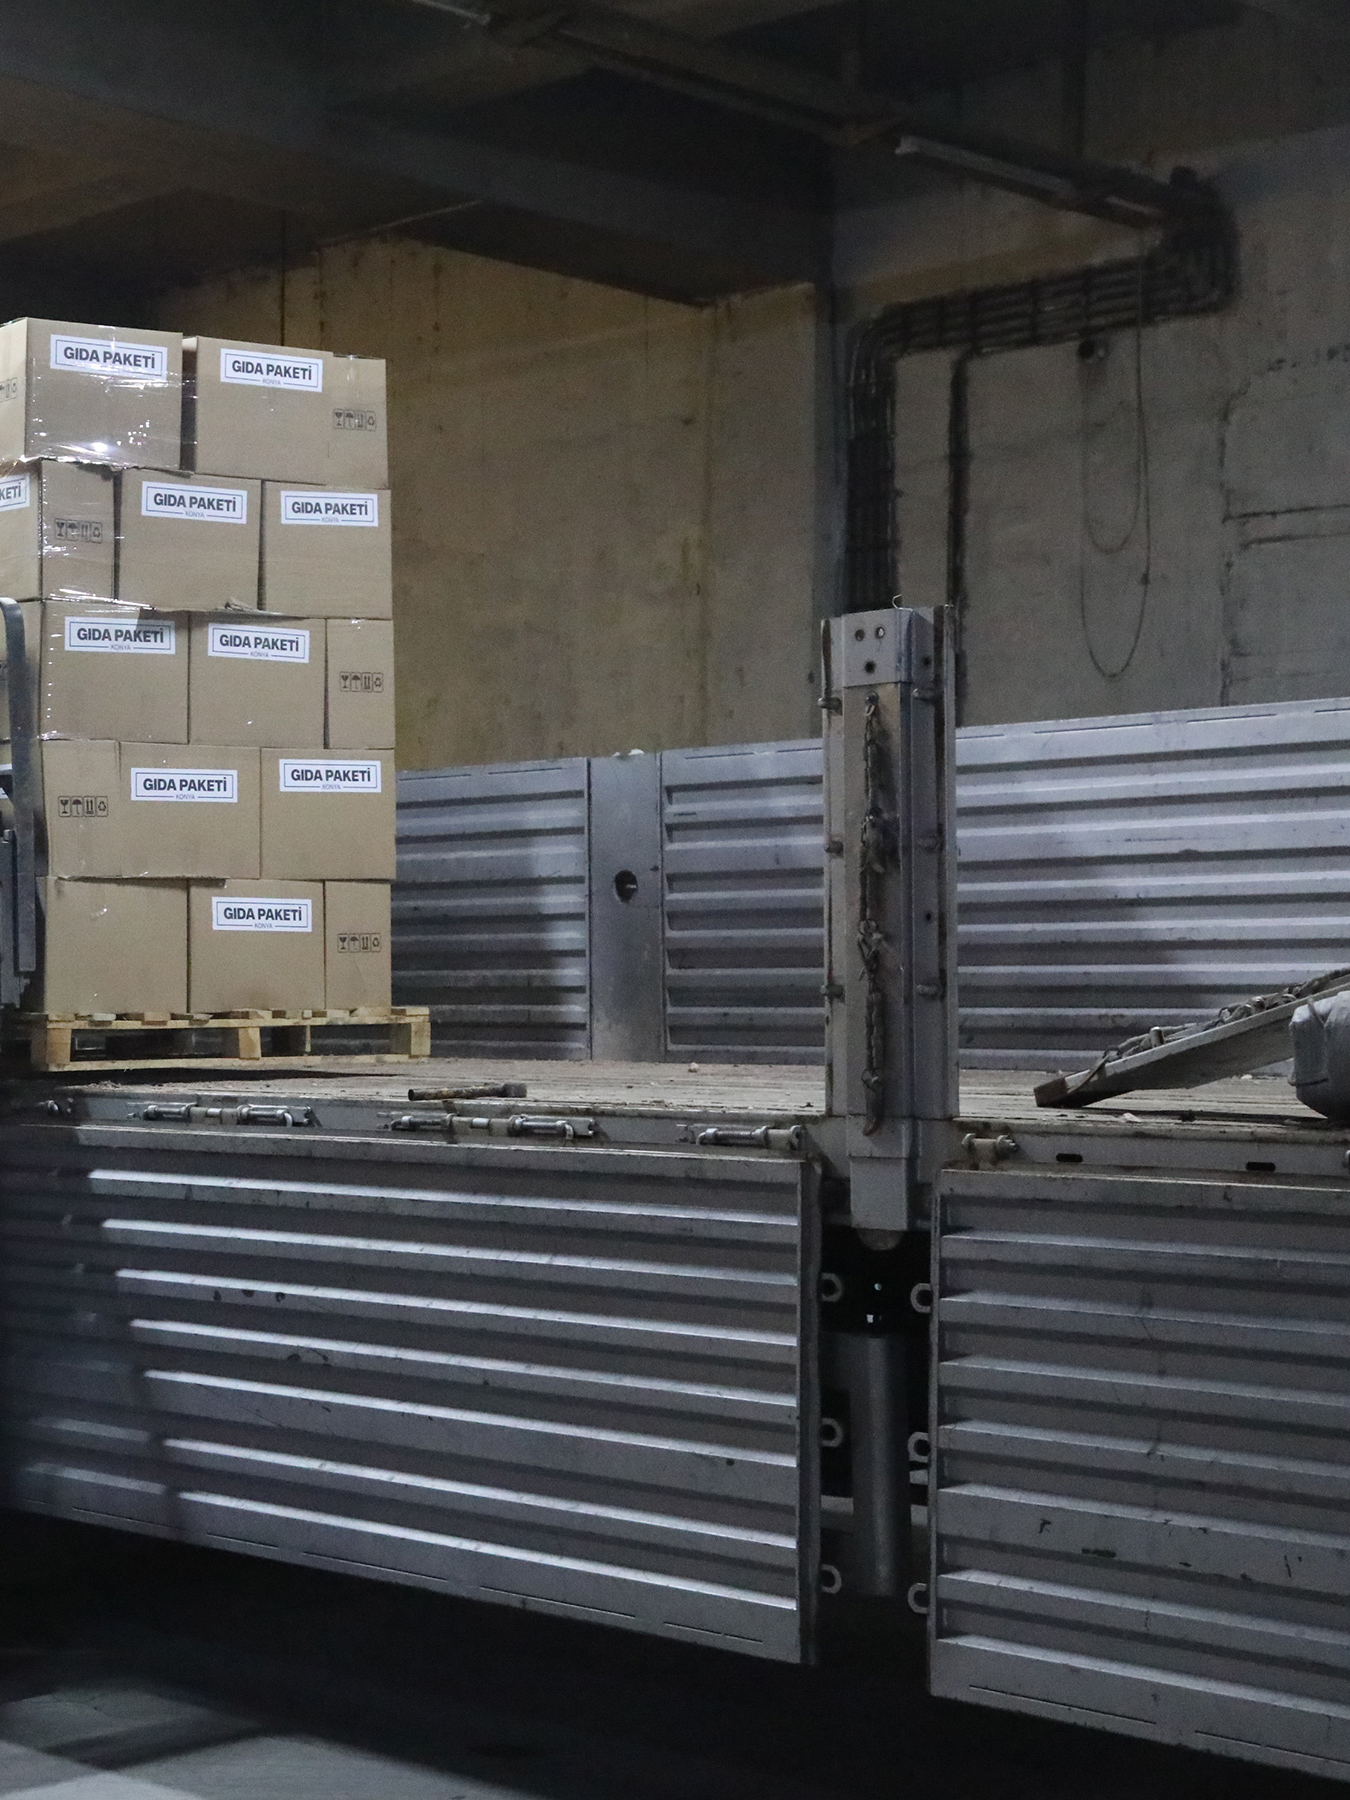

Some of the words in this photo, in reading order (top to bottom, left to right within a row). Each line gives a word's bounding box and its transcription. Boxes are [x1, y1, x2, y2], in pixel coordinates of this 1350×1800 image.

[63, 346, 100, 363] GIDA
[103, 350, 155, 369] PAKETİ
[231, 360, 264, 375] GIDA
[266, 363, 312, 381] PAKETİ
[262, 378, 281, 386] KONYA
[153, 493, 187, 508] GIDA
[189, 496, 237, 512] PAKETİ
[291, 501, 323, 514] GIDA
[324, 500, 368, 516] PAKETİ
[77, 627, 112, 642] GIDA
[114, 627, 164, 643] PAKETİ
[219, 634, 251, 649] GIDA
[253, 636, 299, 652] PAKETİ
[110, 643, 131, 651] KONYA
[291, 768, 323, 782] GIDA
[325, 767, 371, 782] PAKETİ
[143, 778, 177, 791] GIDA
[179, 777, 227, 792] PAKETİ
[223, 906, 255, 920] GIDA
[257, 906, 302, 921] PAKETİ
